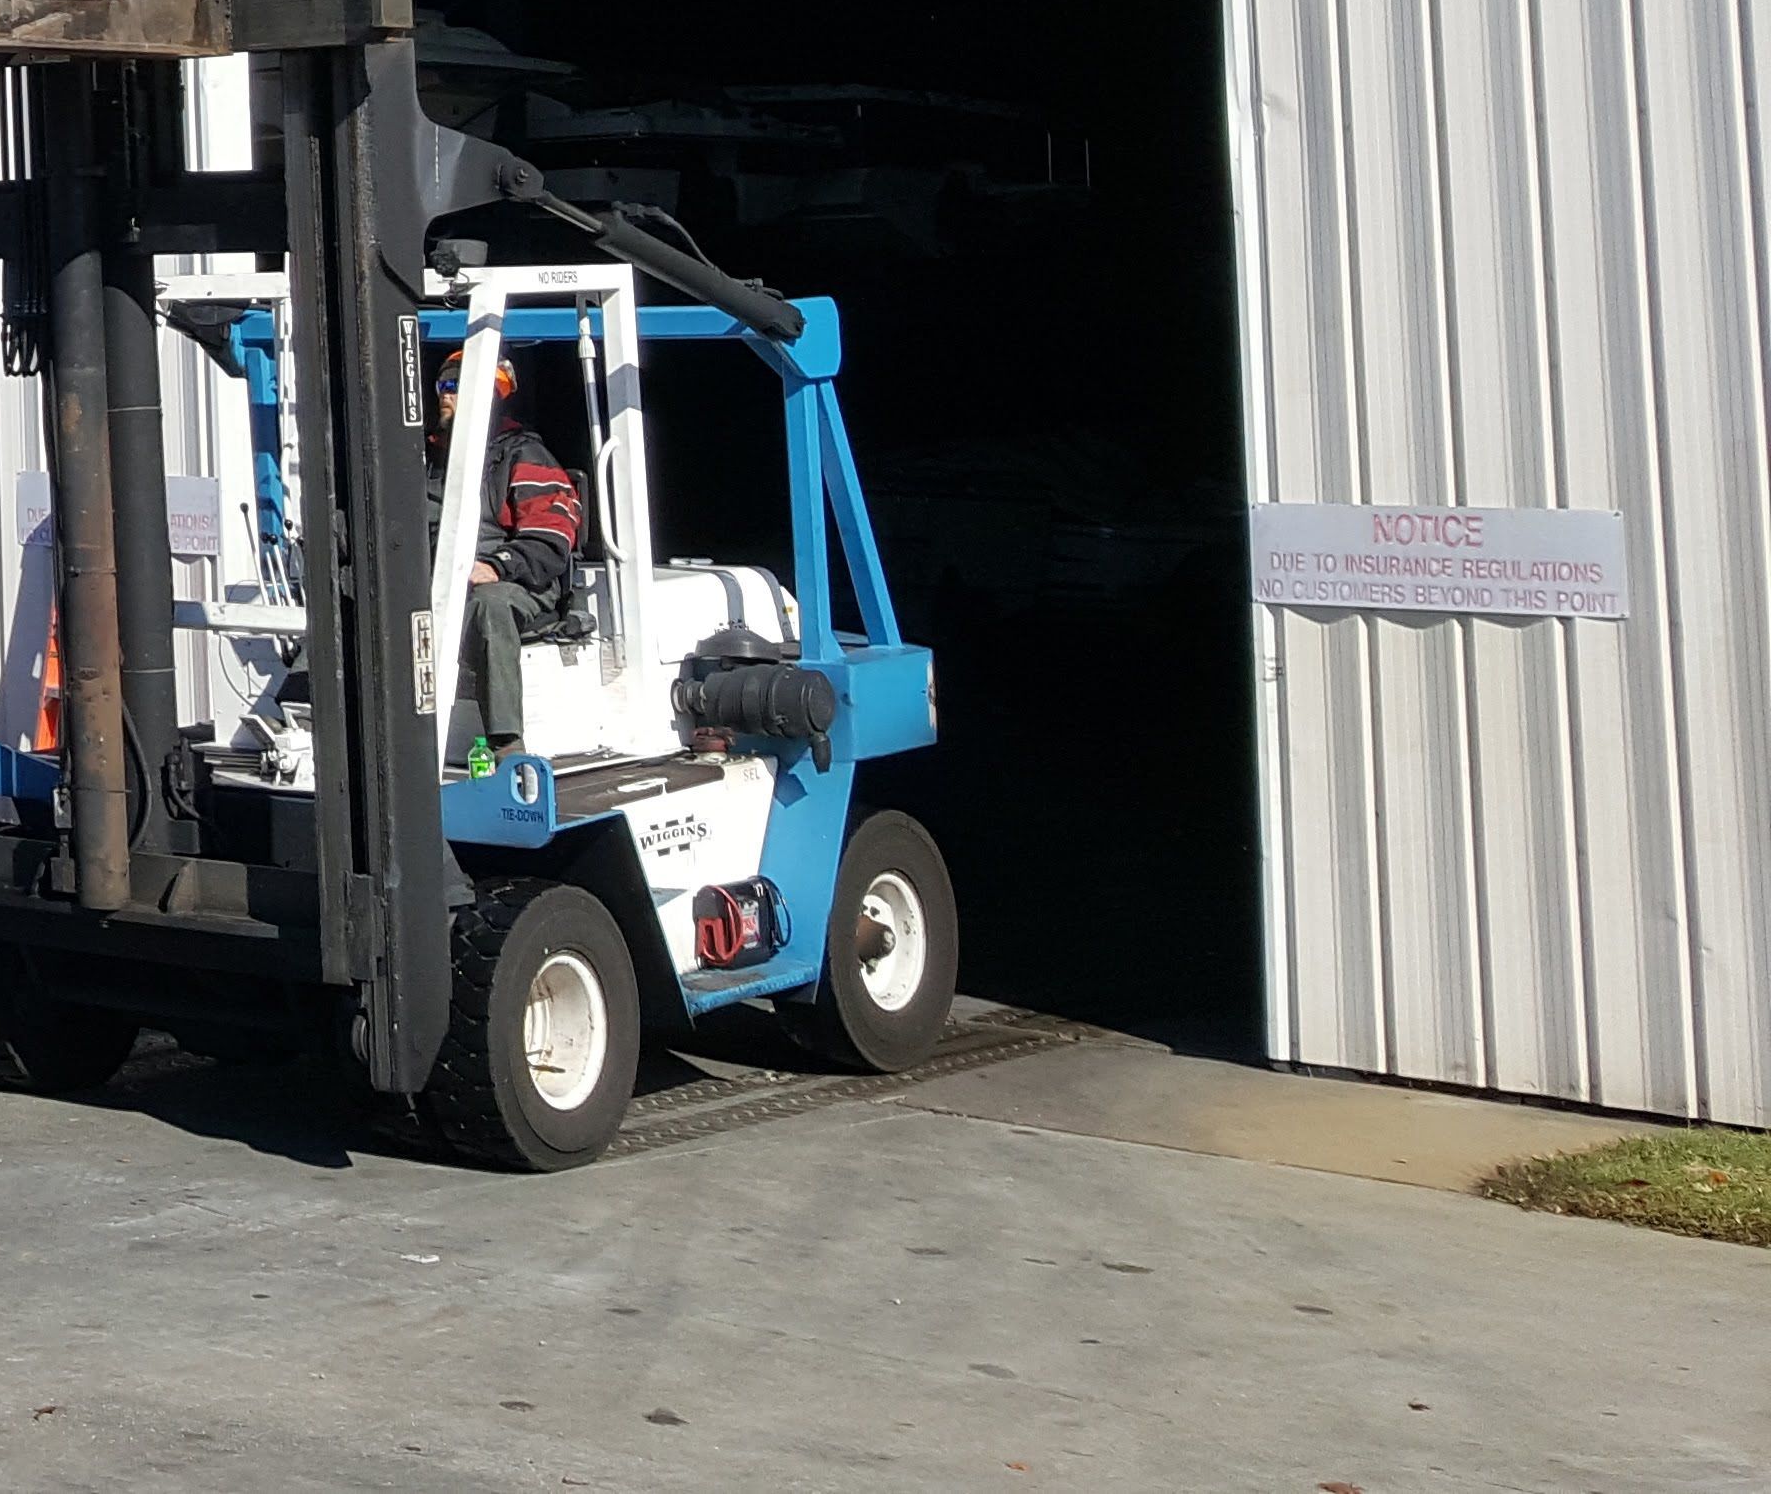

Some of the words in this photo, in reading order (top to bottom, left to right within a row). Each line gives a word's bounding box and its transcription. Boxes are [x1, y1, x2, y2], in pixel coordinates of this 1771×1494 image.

[538, 271, 549, 284] NO
[551, 270, 578, 283] RIDERS
[402, 320, 417, 421] WIGGINS
[1372, 513, 1484, 548] NOTICE
[1270, 552, 1306, 572] DUE
[1311, 553, 1337, 574] TO
[1345, 554, 1453, 577] INSURANCE
[1462, 558, 1604, 583] REGULATIONS
[1259, 578, 1284, 598] NO
[1292, 579, 1406, 604] CUSTOMERS
[1415, 585, 1493, 609] BEYOND
[1500, 588, 1548, 611] THIS
[1557, 592, 1618, 614] POINT
[501, 808, 544, 823] TIE-DOWN
[640, 822, 707, 850] WIGGINS
